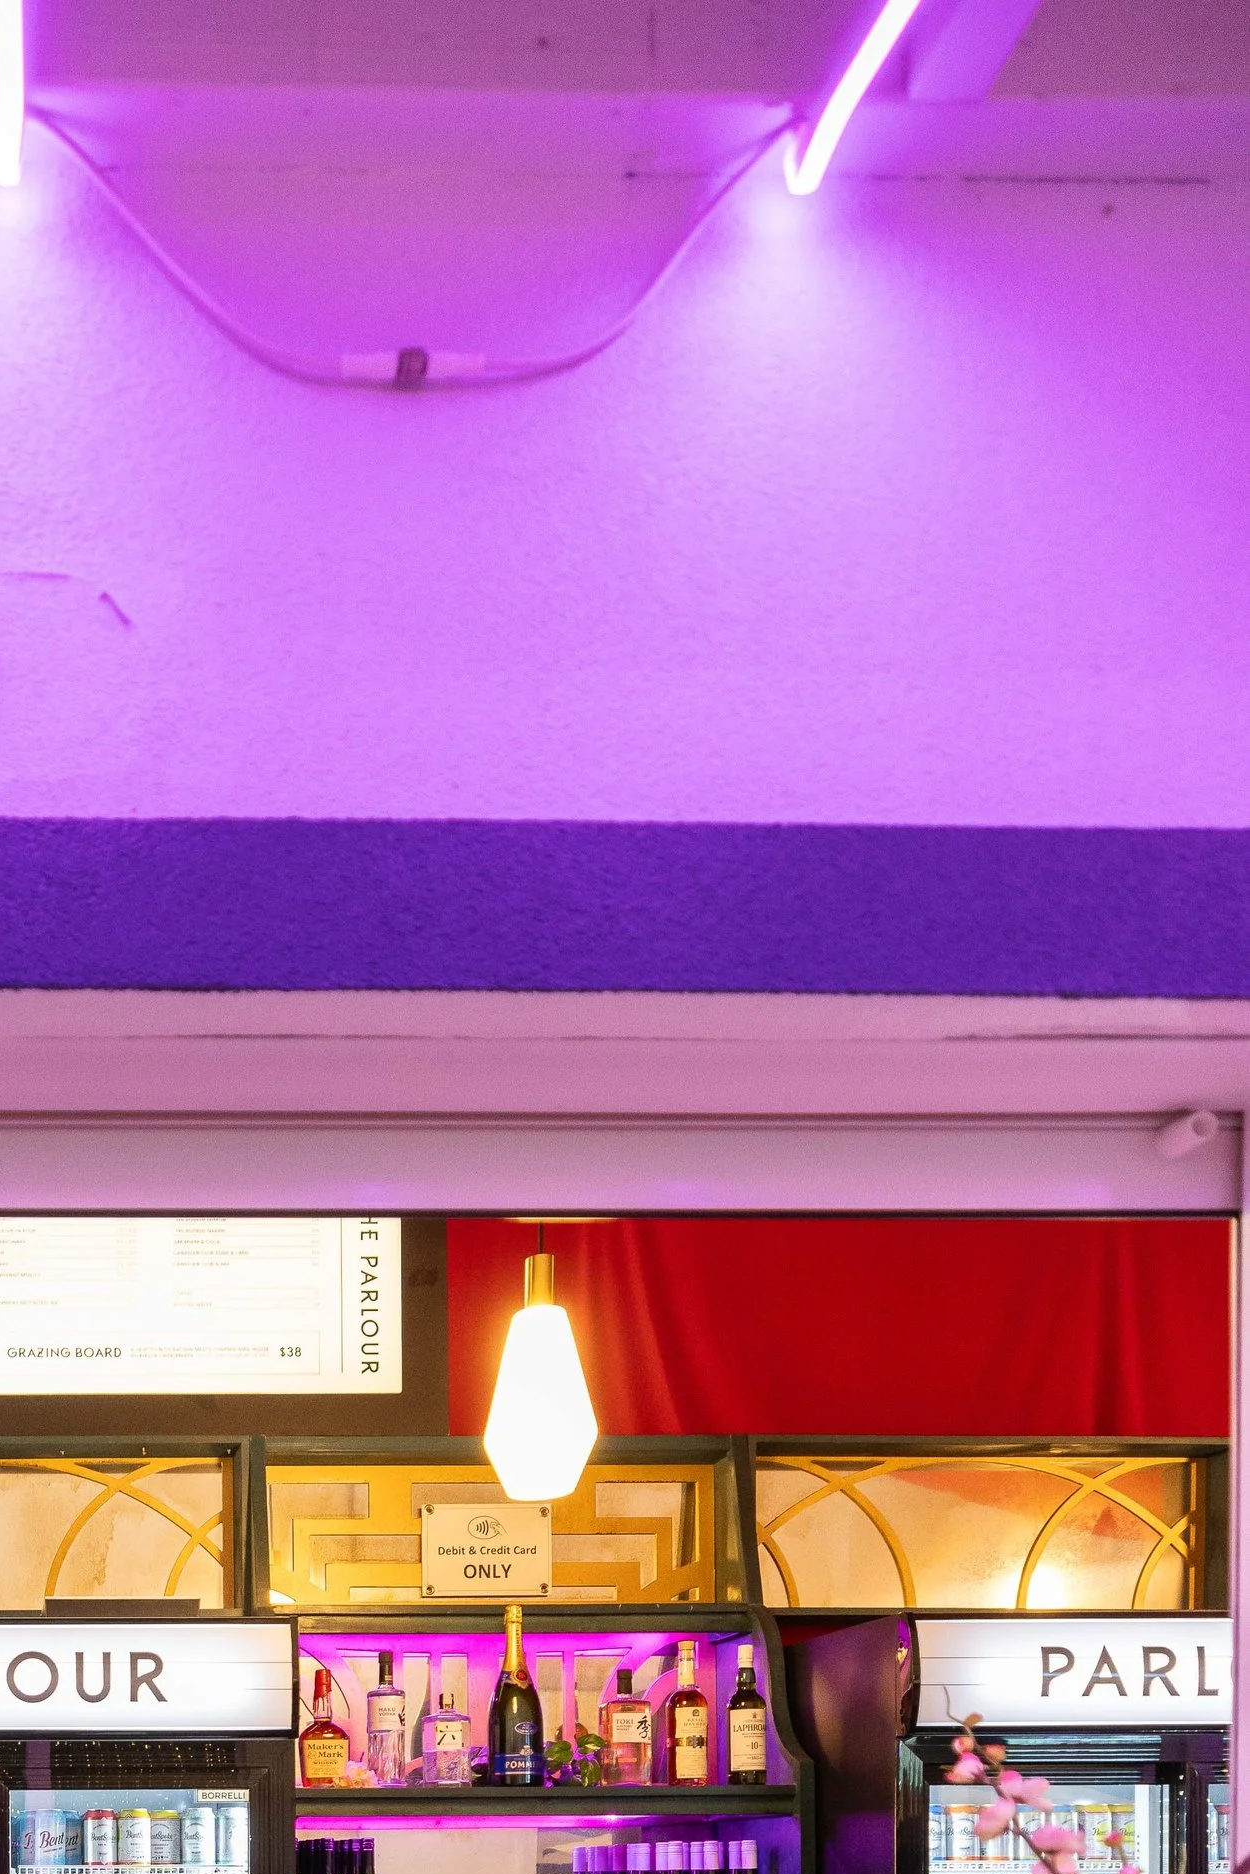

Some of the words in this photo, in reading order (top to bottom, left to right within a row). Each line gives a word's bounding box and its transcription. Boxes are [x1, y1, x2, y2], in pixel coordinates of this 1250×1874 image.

[359, 1217, 378, 1241] HE
[359, 1256, 379, 1374] PARLOUR
[7, 1347, 71, 1359] GRAZING
[75, 1347, 122, 1359] BOARD
[280, 1346, 302, 1358] $38
[438, 1546, 465, 1556] Debit
[468, 1546, 477, 1555] &
[480, 1545, 511, 1555] Credit
[513, 1545, 537, 1555] Card
[463, 1563, 512, 1579] ONLY
[1040, 1644, 1219, 1697] PARL
[733, 1723, 766, 1733] LAPHROA
[307, 1743, 344, 1751] Maker's
[750, 1741, 759, 1750] 10
[318, 1750, 343, 1759] Mark
[201, 1791, 246, 1800] BORRELLI
[39, 1830, 64, 1849] Bent
[65, 1833, 79, 1847] ent
